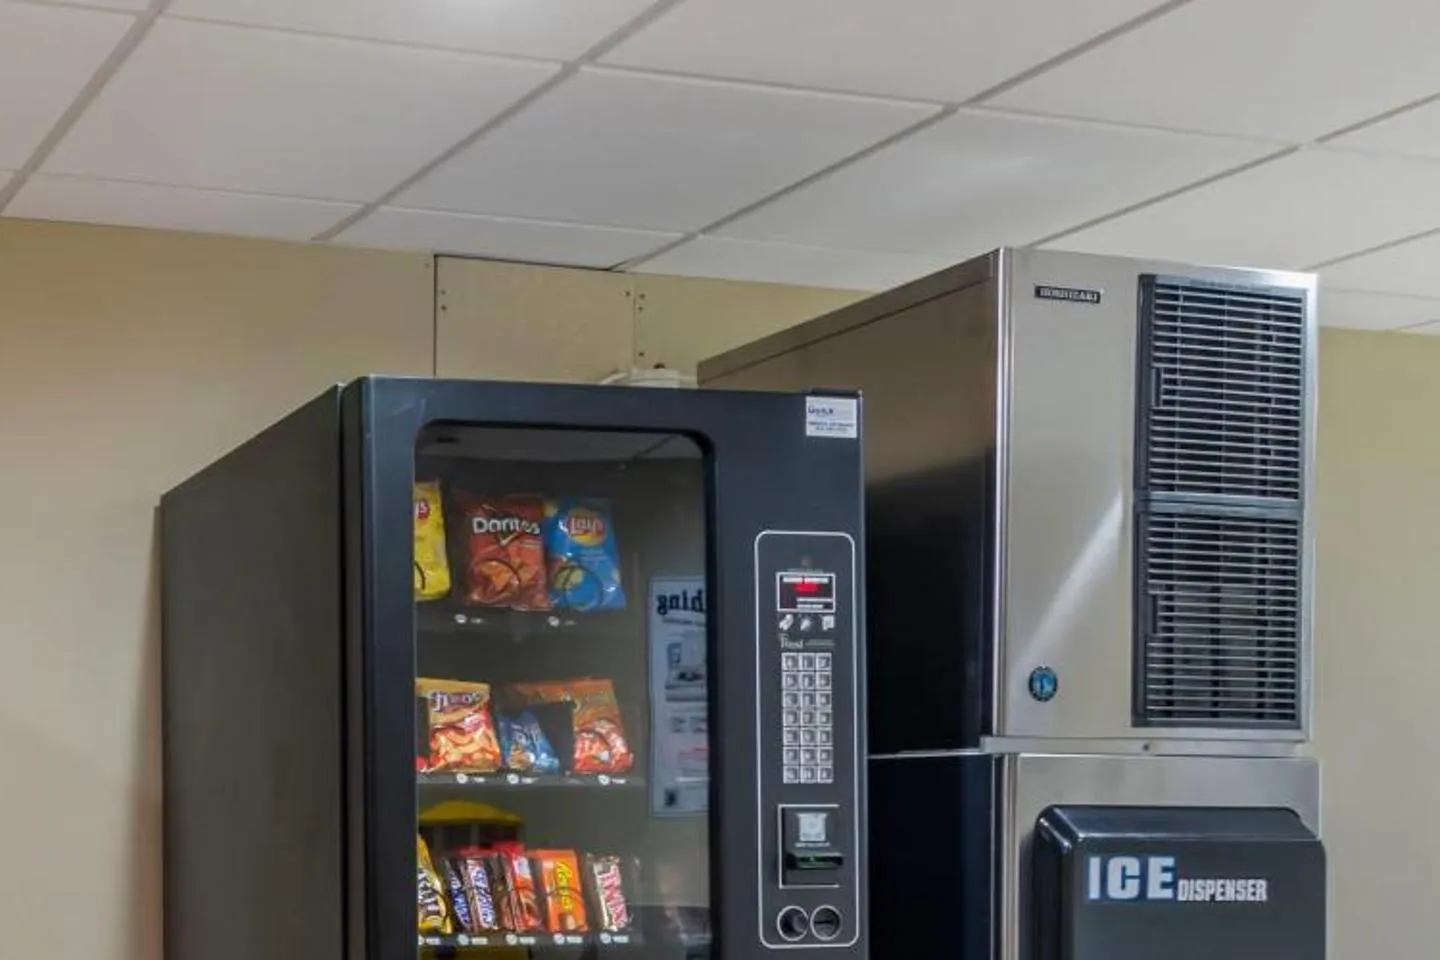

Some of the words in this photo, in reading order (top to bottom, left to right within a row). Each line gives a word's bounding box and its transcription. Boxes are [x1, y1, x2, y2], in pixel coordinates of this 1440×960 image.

[472, 516, 540, 535] Doritos
[1088, 856, 1175, 900] ICE
[1177, 878, 1268, 902] DISPENSER
